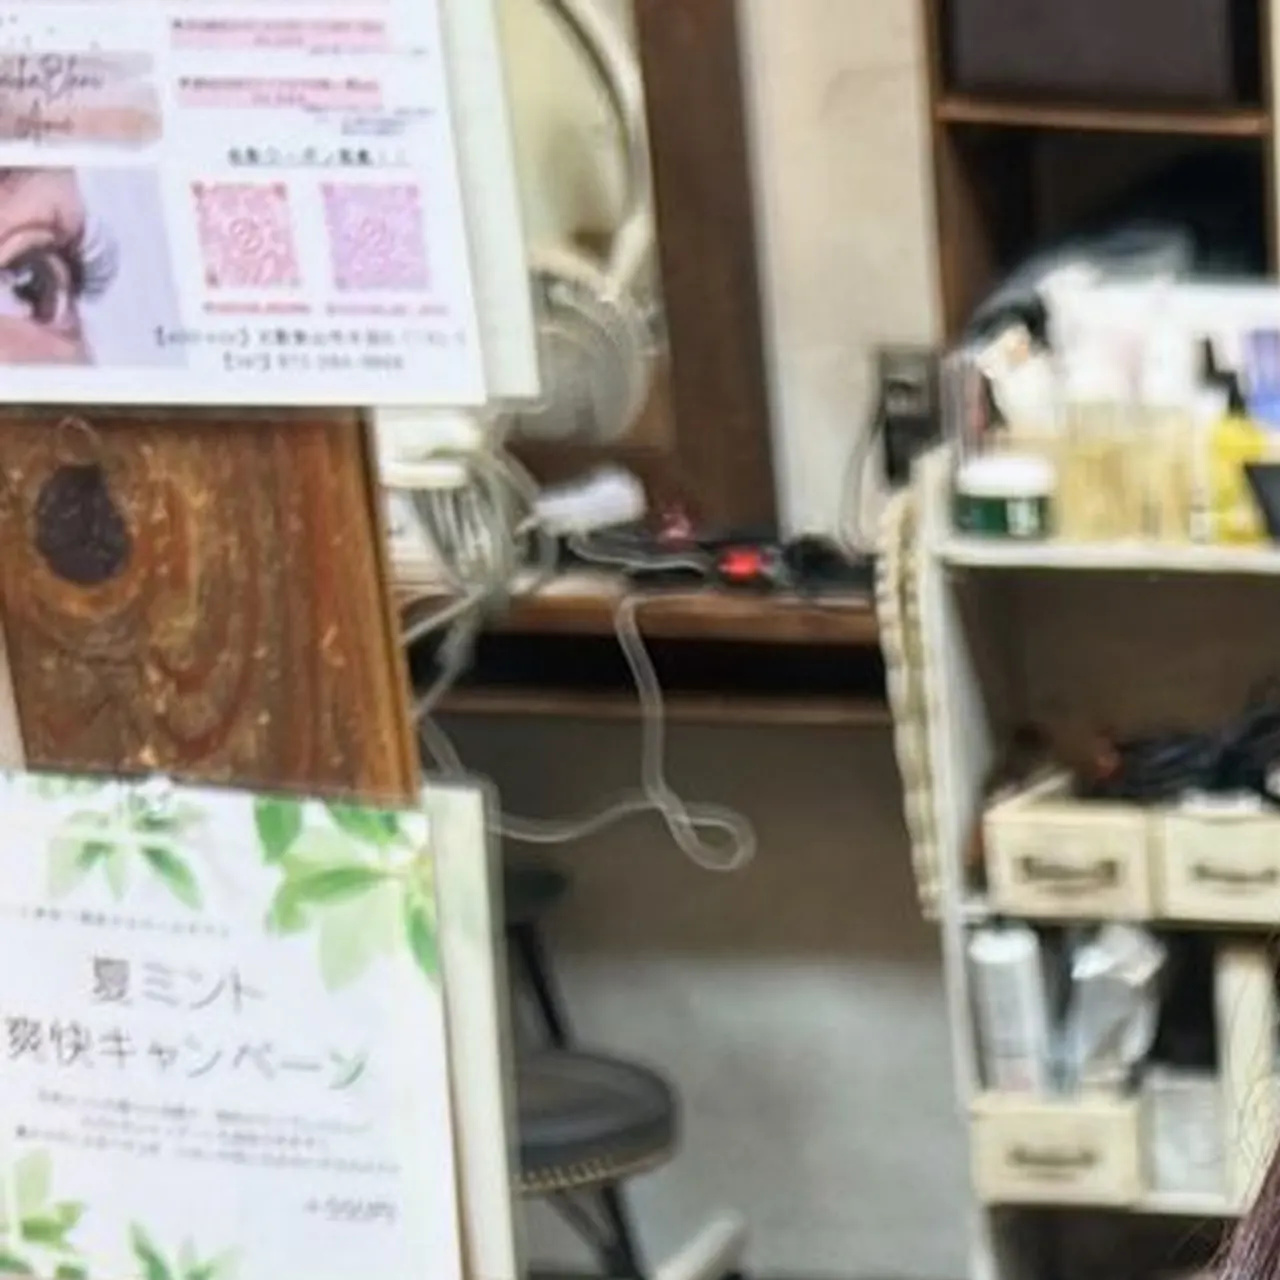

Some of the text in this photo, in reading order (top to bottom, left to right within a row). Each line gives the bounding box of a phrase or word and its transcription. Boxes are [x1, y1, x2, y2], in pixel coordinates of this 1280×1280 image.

[92, 954, 266, 1013] 夏ミント
[5, 1014, 369, 1090] 爽快キャンペーン
